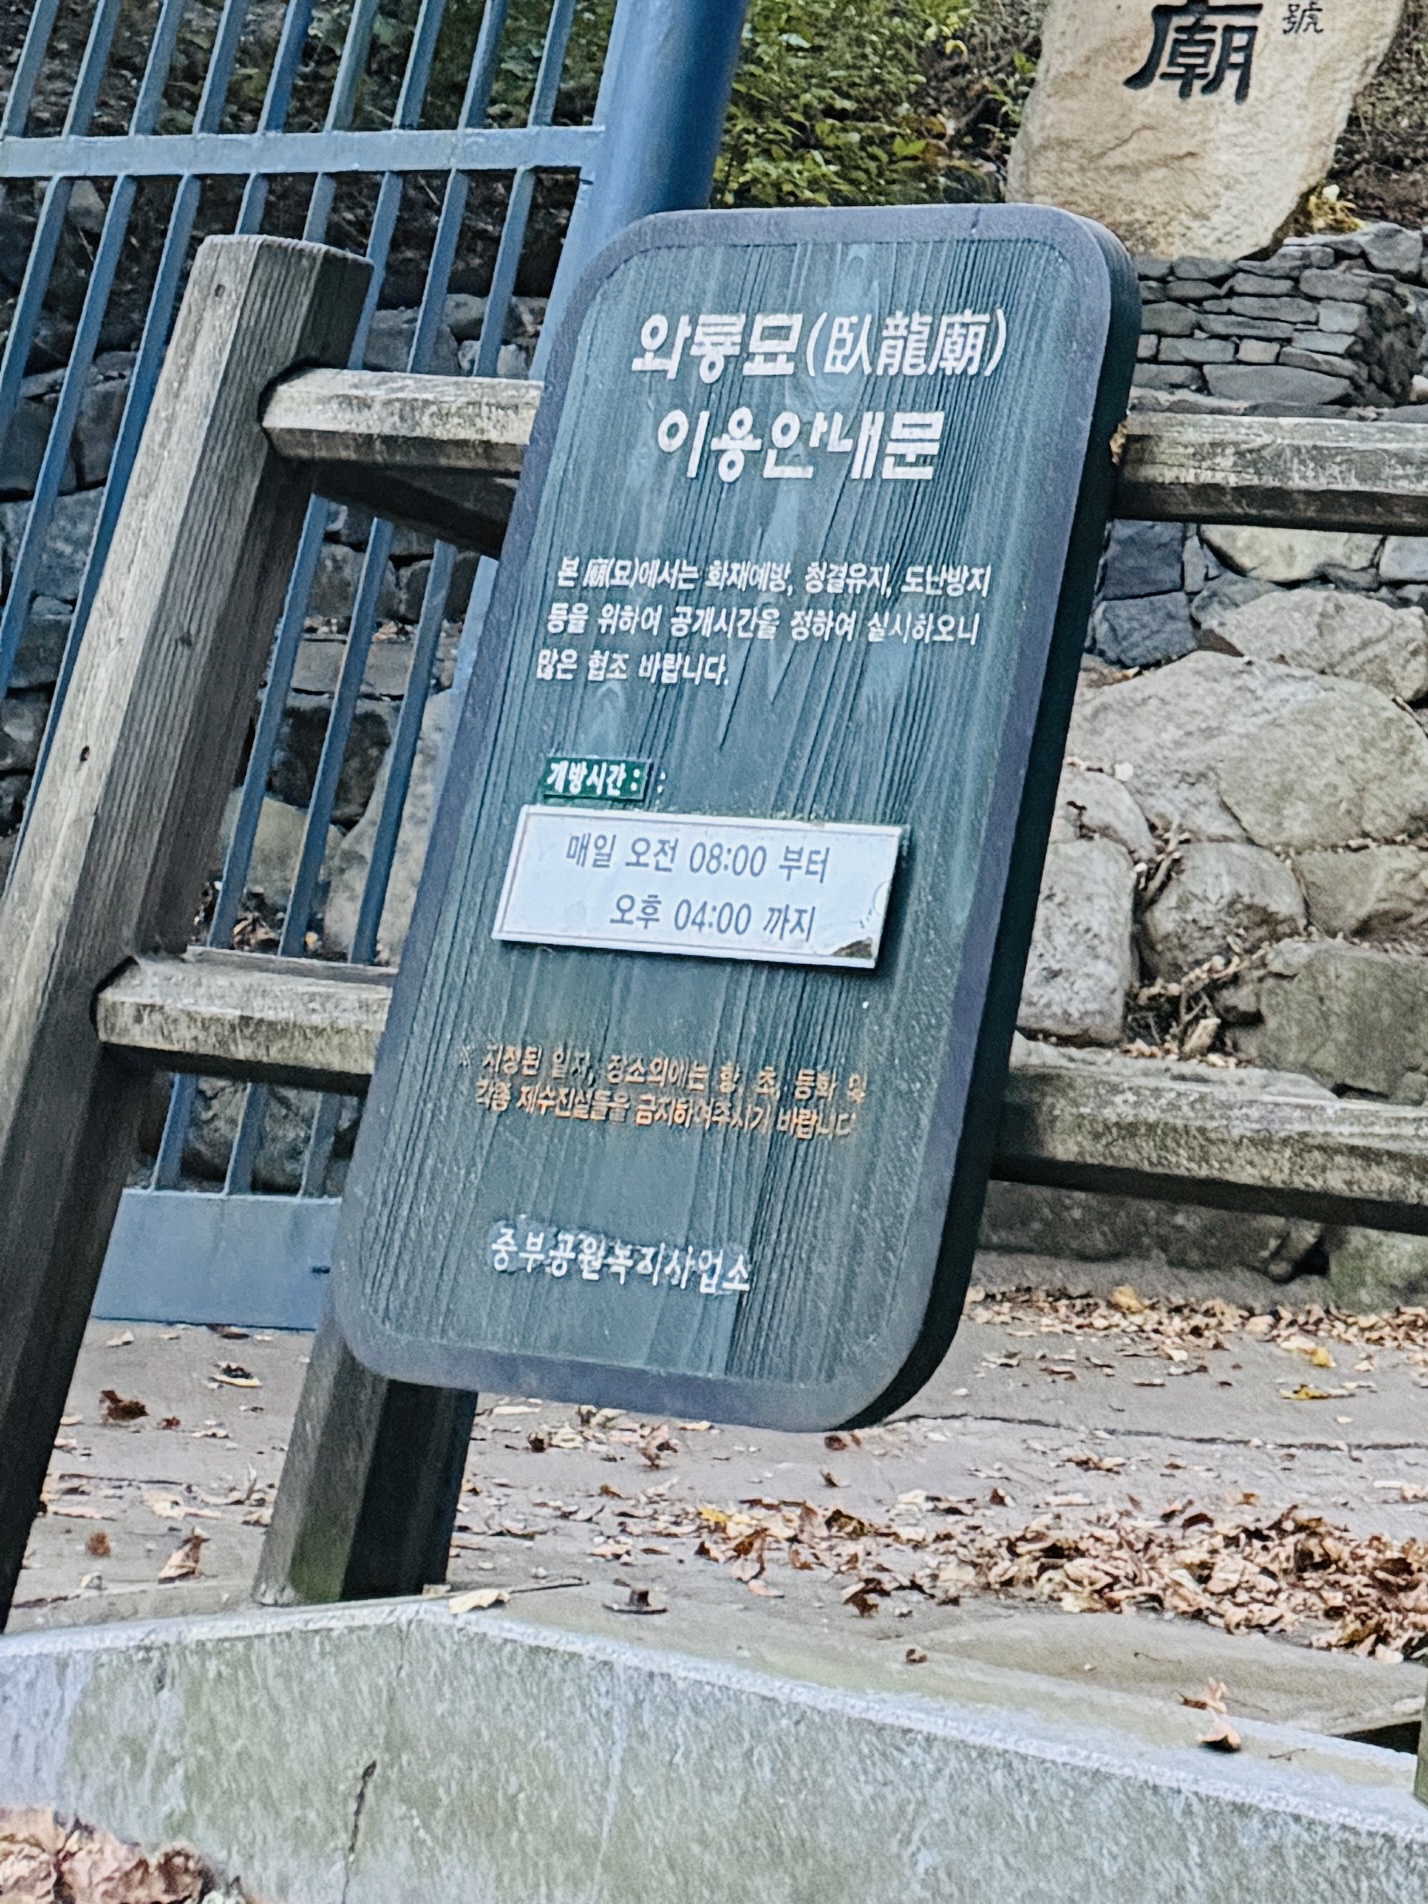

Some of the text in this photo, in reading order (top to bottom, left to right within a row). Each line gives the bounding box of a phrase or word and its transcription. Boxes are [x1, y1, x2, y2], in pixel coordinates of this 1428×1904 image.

[657, 407, 945, 483] 이용안내문
[557, 556, 580, 587] 본
[705, 560, 793, 597] 화재예방,
[805, 560, 892, 597] 청결유지,
[901, 564, 991, 598] 도난방지
[547, 602, 981, 645] 등을 위하여 공개시간을 정하여 실시하오니
[536, 648, 729, 686] 많은 협조 바랍니다.
[566, 832, 831, 884] 매일 오전 08:00 부터
[610, 894, 816, 942] 오후 04:00 까지
[482, 1043, 543, 1076] 지정된
[635, 1092, 771, 1135] 금지하여주시기
[491, 1227, 750, 1293] 중부공원녹지사업소
